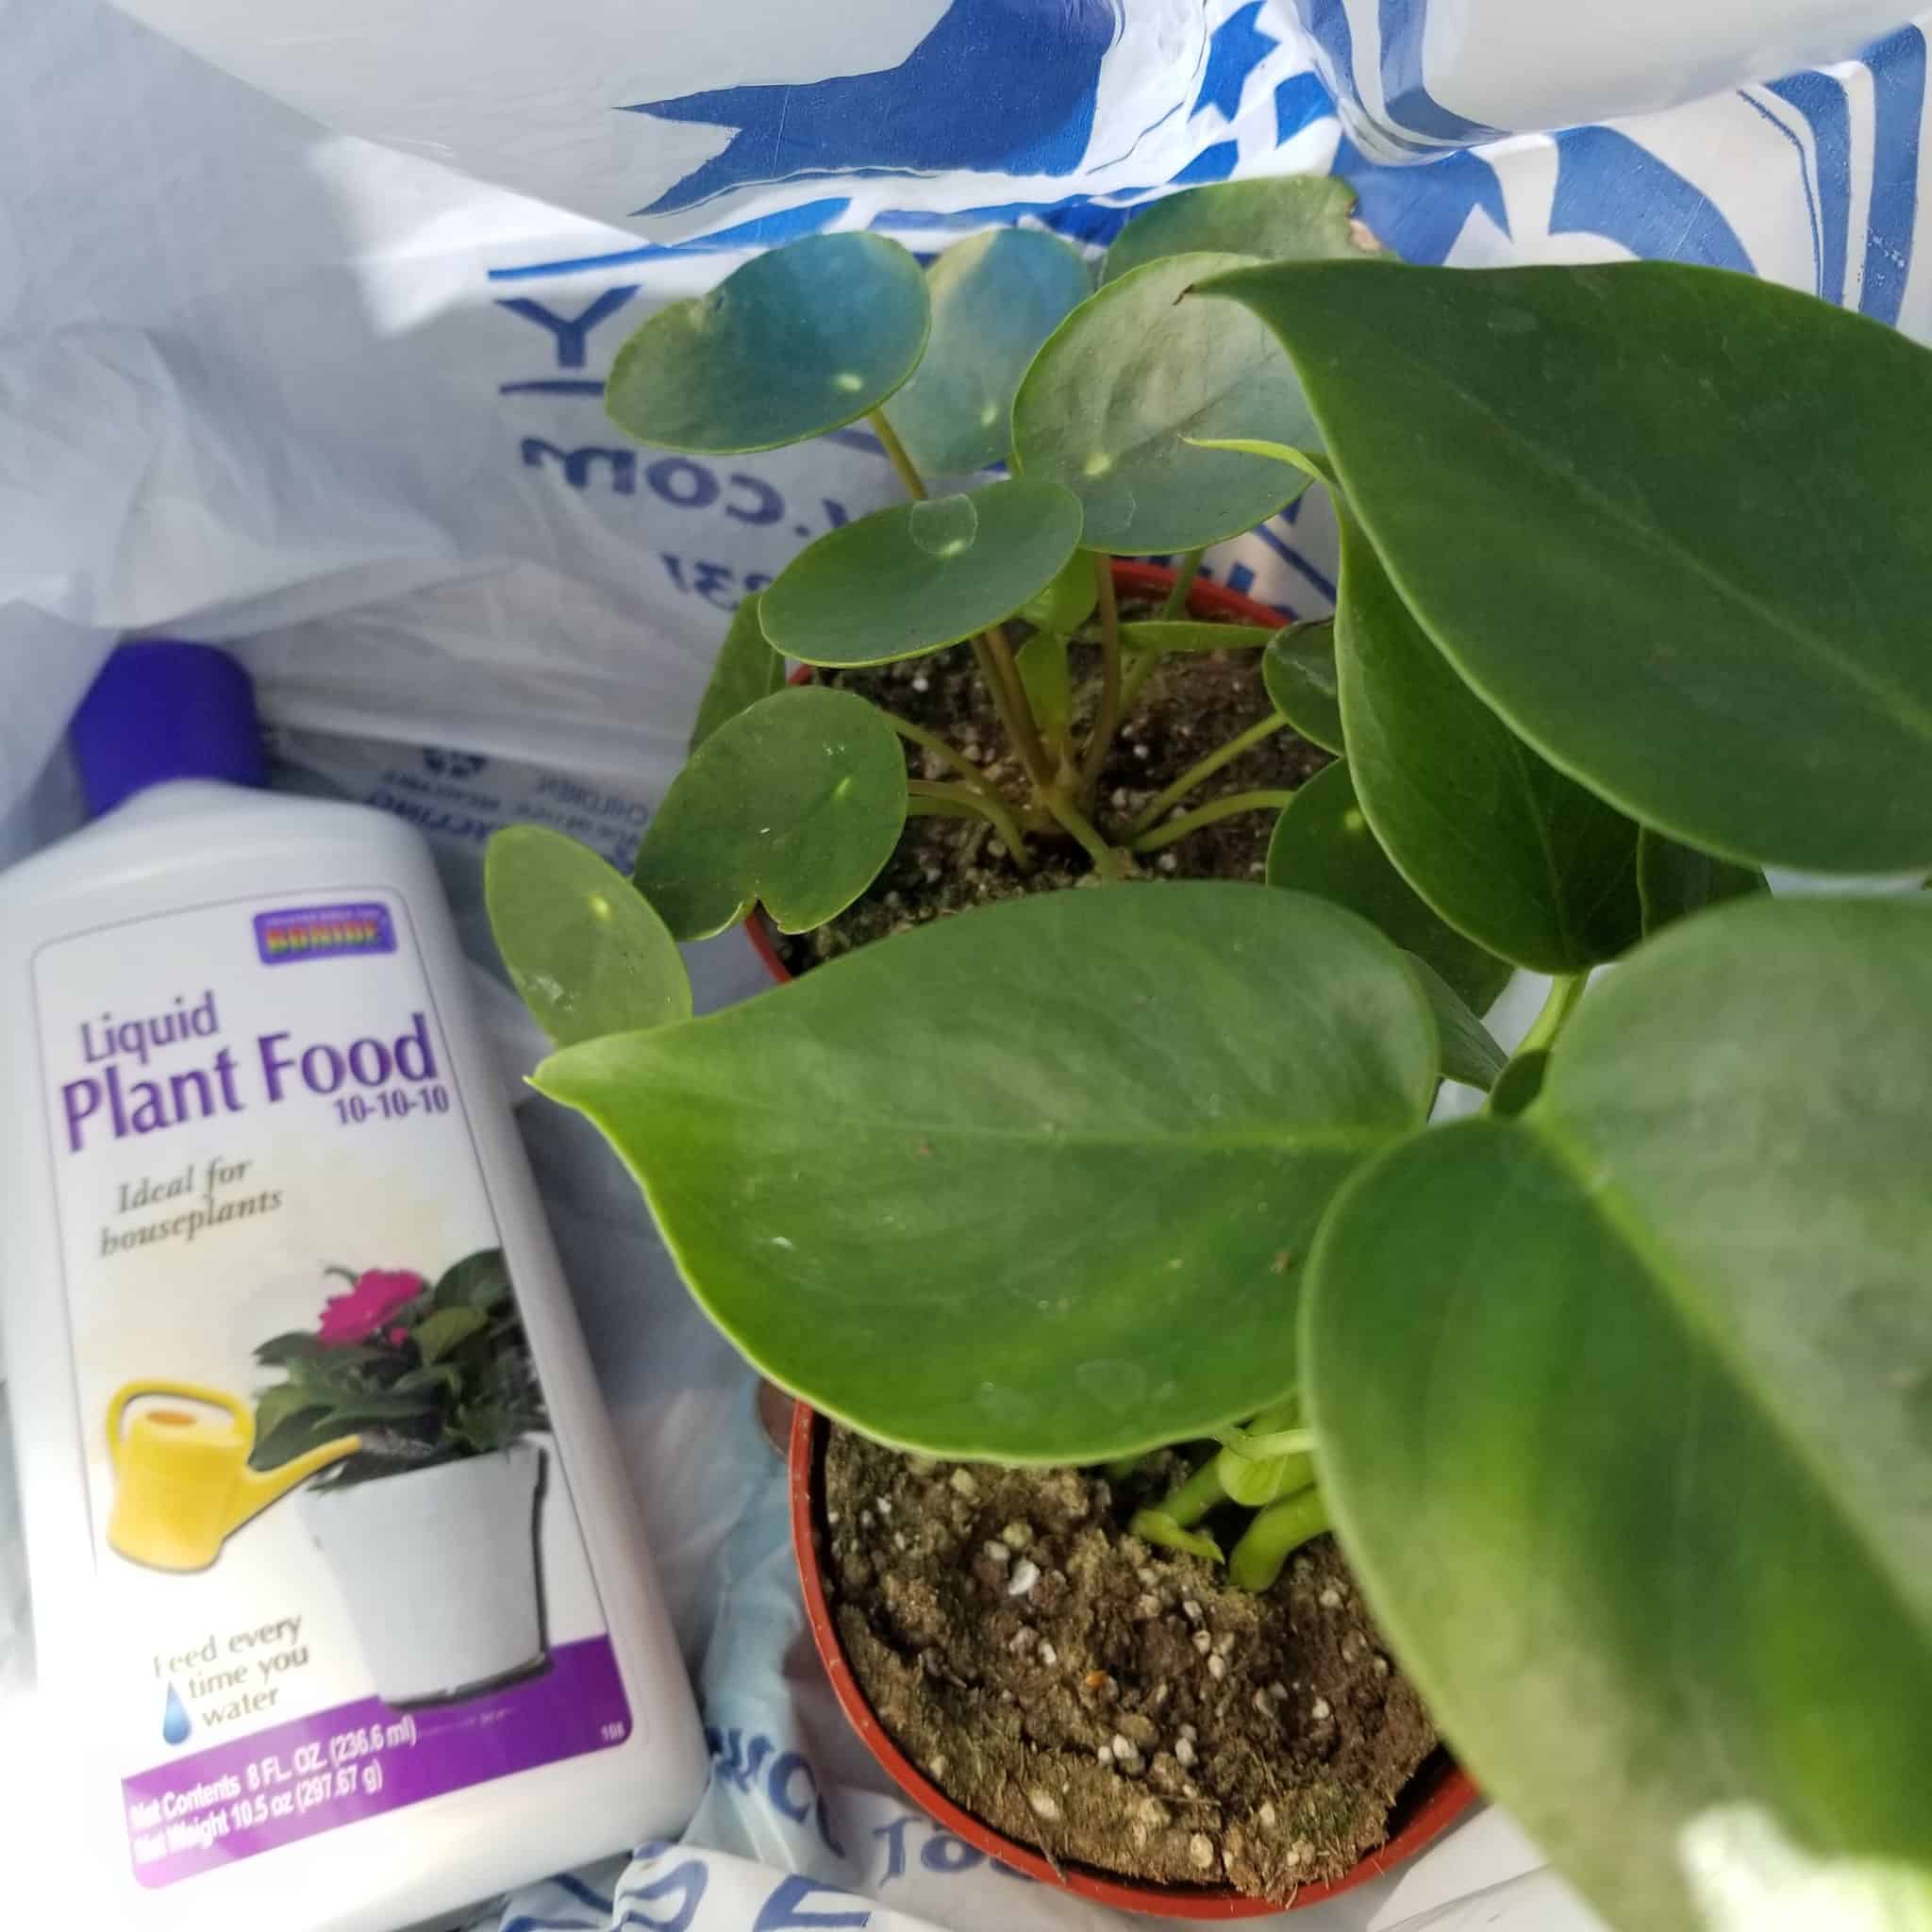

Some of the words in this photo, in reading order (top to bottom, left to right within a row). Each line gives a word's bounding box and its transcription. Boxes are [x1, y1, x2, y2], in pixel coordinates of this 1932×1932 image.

[79, 990, 220, 1066] Liquid
[61, 1046, 245, 1154] Plant
[258, 1011, 440, 1105] Food
[334, 1085, 451, 1125] 10-10-10
[115, 1163, 194, 1214] Ideal
[202, 1155, 254, 1197] for
[99, 1190, 284, 1258] houseplants
[228, 1613, 302, 1653] every
[189, 1666, 248, 1698] time
[258, 1645, 309, 1685] you
[202, 1688, 279, 1726] water
[162, 1774, 242, 1820] Contents
[246, 1762, 261, 1790] 8
[165, 1808, 230, 1853] Weight
[231, 1794, 269, 1830] 10.5
[271, 1791, 295, 1817] oz
